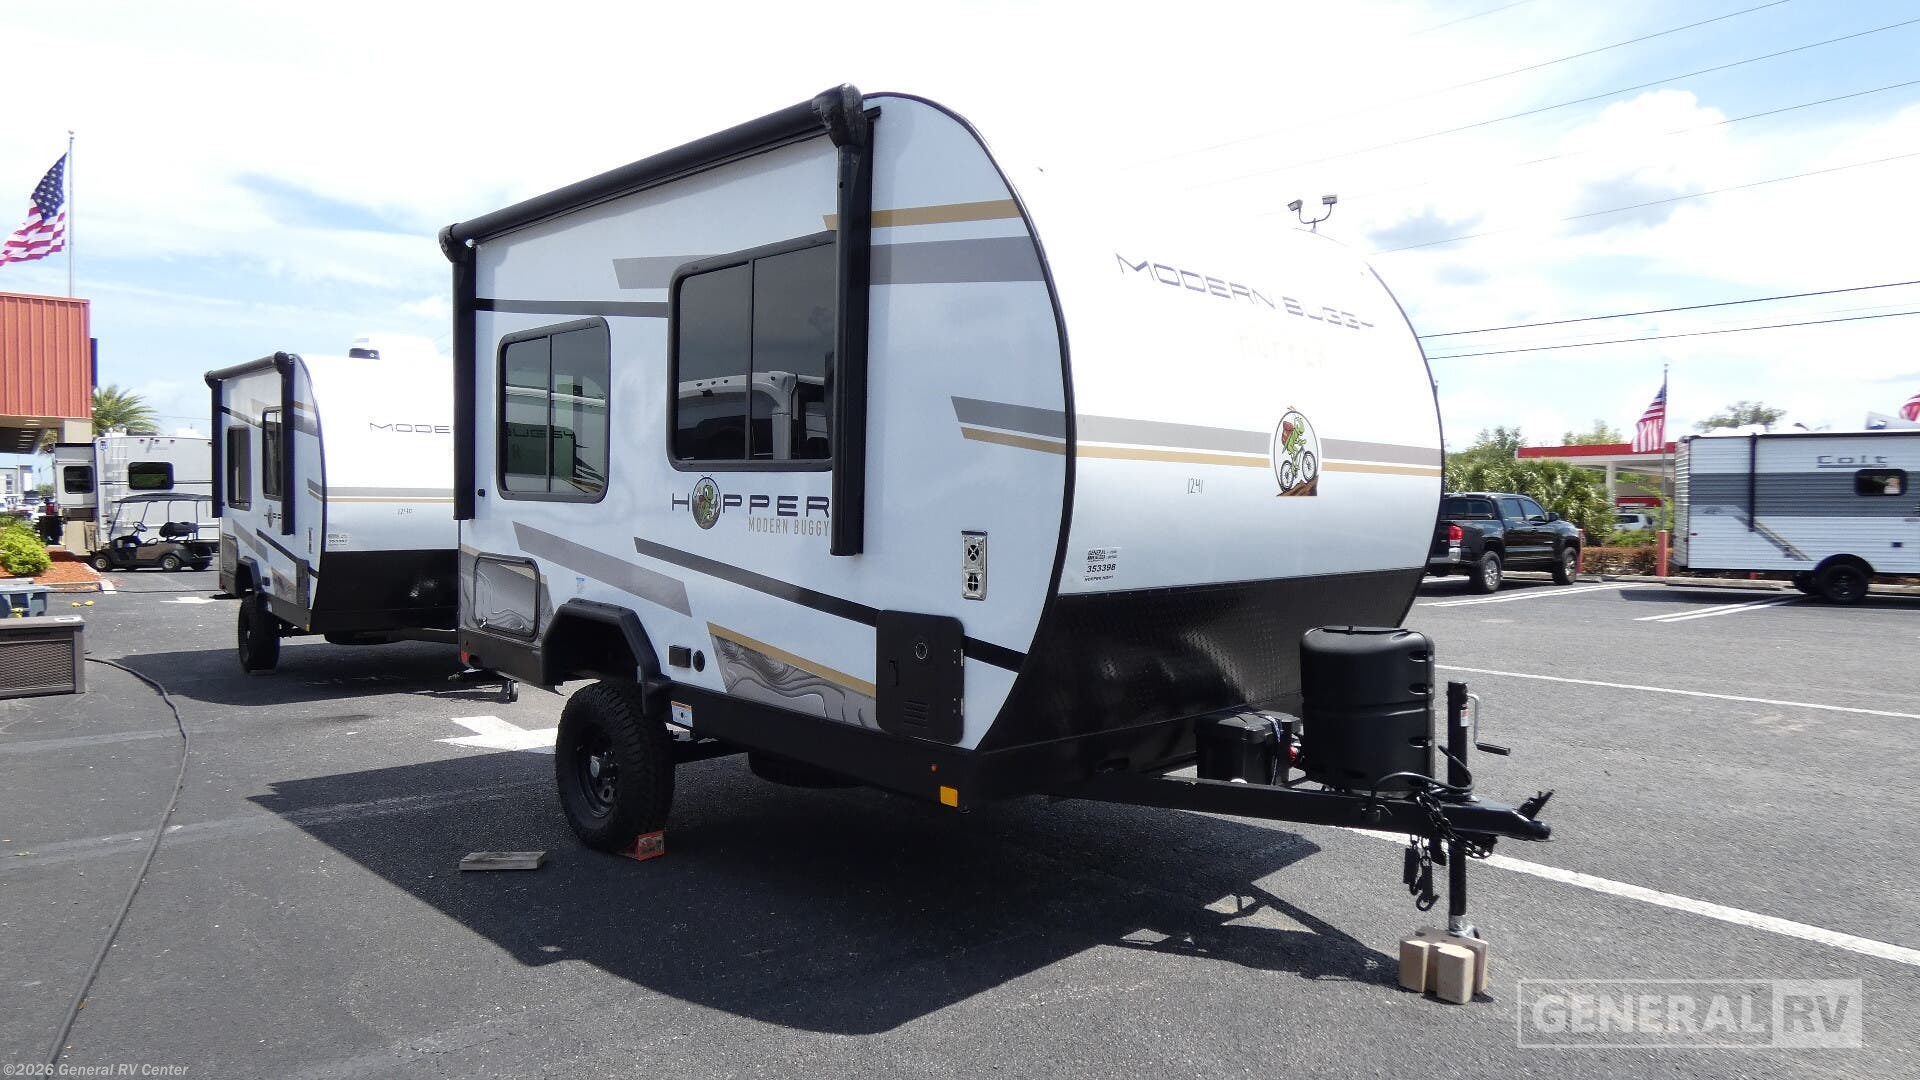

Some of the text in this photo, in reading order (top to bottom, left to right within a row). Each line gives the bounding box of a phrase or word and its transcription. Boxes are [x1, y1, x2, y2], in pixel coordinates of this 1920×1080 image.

[1115, 252, 1275, 309] MODERN
[1816, 455, 1888, 464] Colt
[748, 517, 830, 537] MODERN BUGGY
